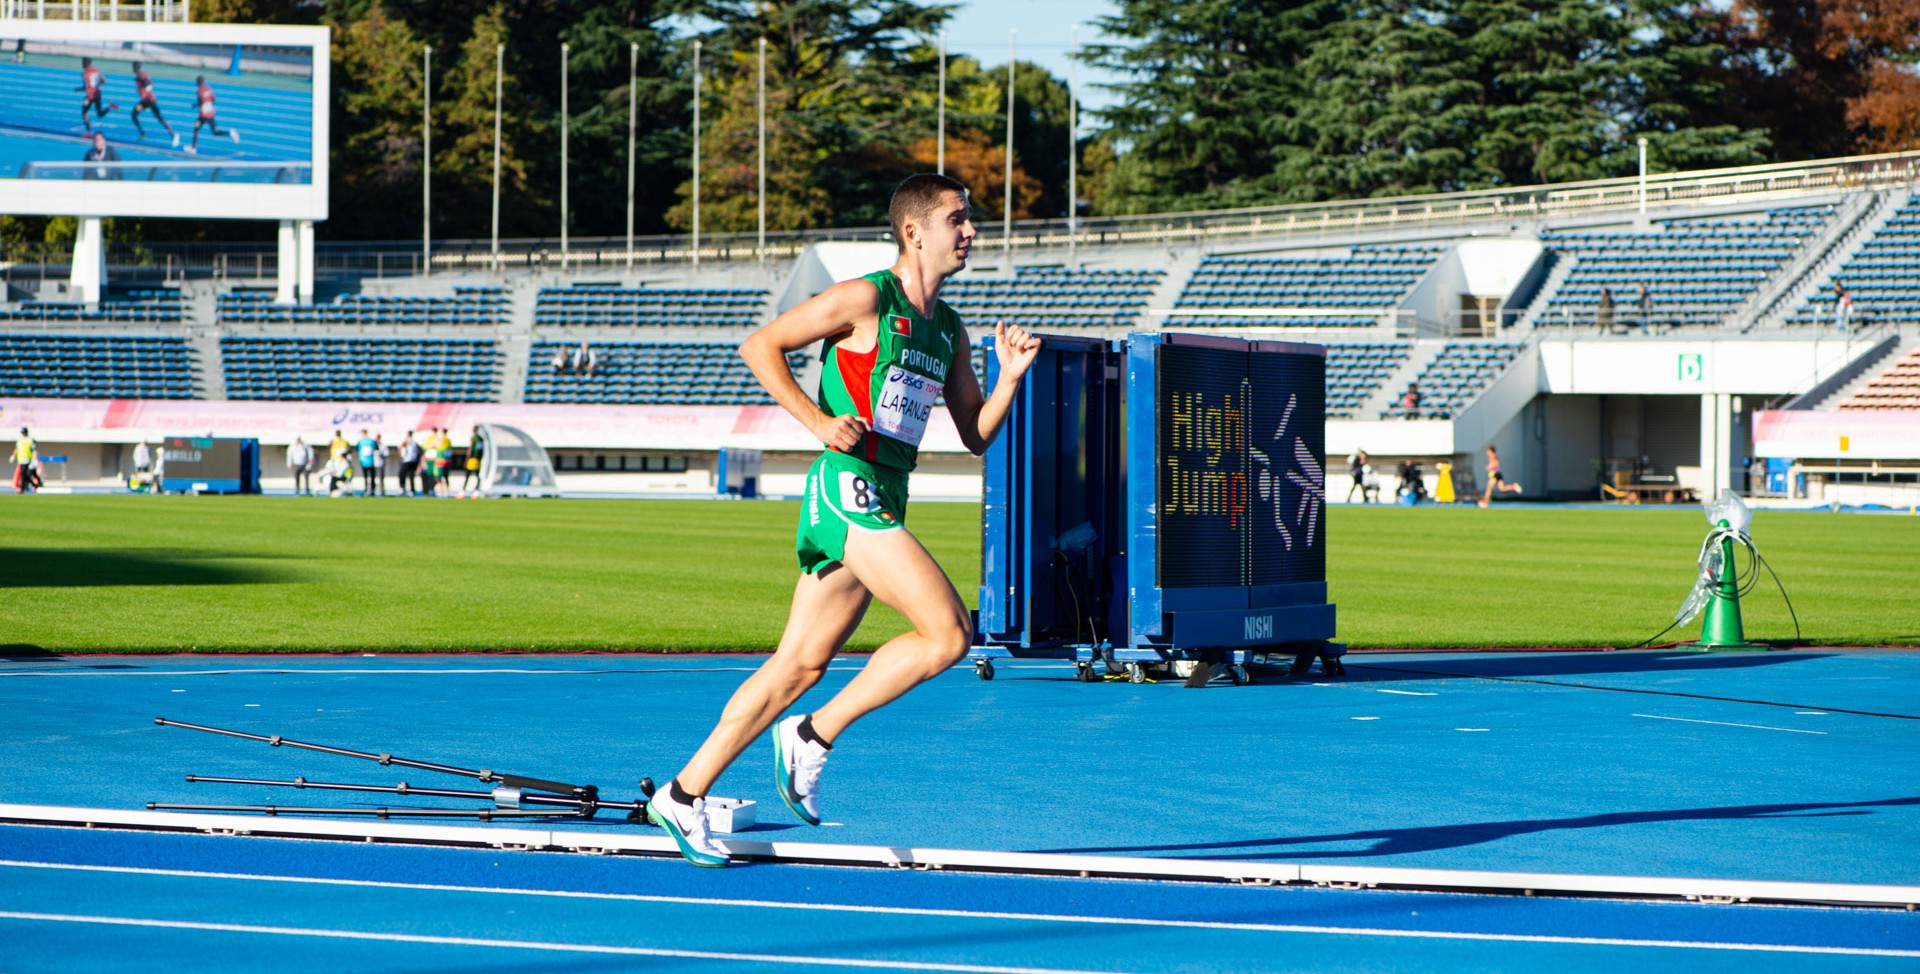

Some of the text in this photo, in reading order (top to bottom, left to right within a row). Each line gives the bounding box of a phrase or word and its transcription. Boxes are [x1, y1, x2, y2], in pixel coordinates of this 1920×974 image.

[902, 375, 925, 390] asics
[1682, 359, 1700, 381] D
[350, 411, 384, 424] asics
[1172, 391, 1241, 467] High
[809, 474, 820, 527] PORTUGAL
[852, 476, 870, 508] 8
[1165, 455, 1247, 530] Jump
[1244, 615, 1273, 640] NISHI
